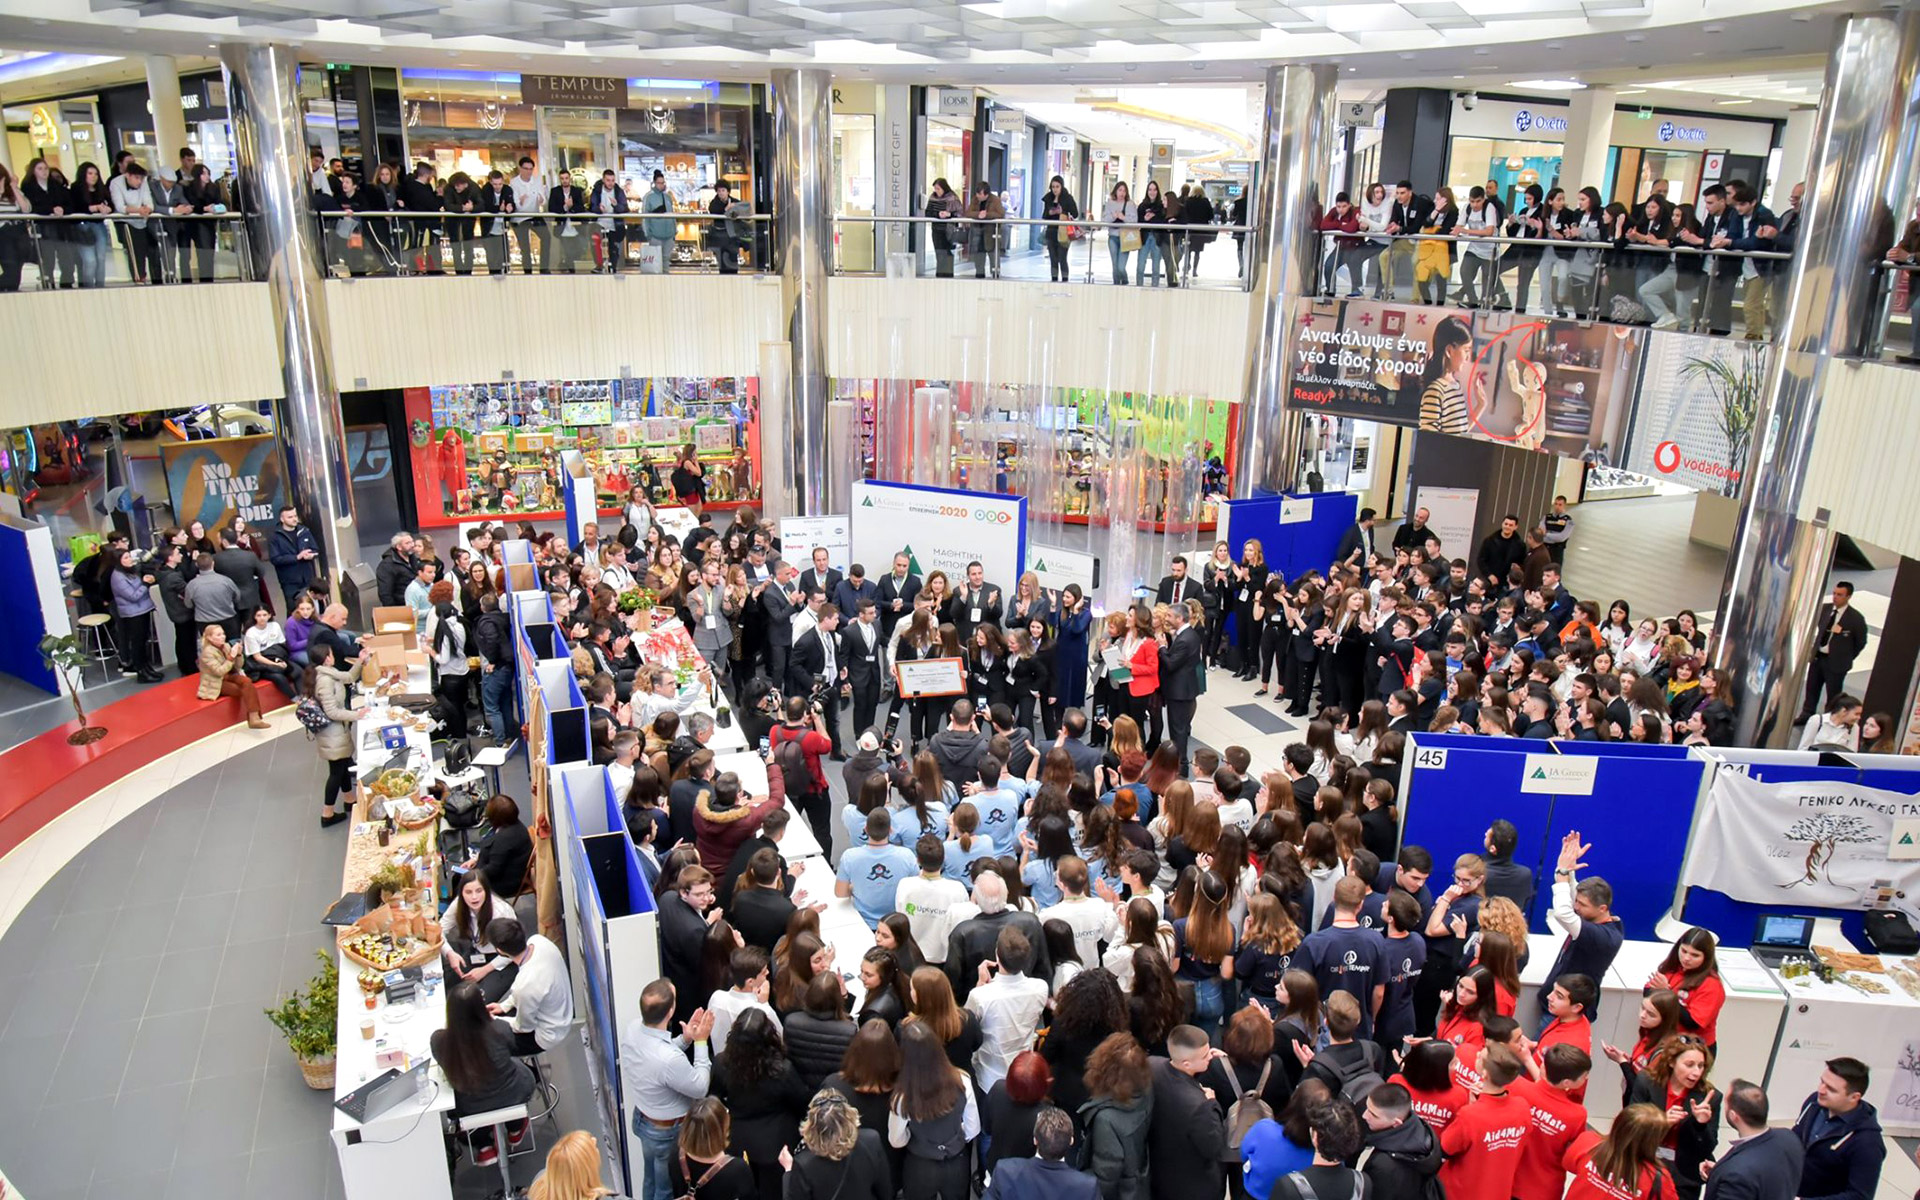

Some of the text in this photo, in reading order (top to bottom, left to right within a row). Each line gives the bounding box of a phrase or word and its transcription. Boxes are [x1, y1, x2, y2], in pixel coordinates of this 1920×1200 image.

[532, 76, 616, 92] TEMPUS
[943, 96, 969, 106] LOISIR
[892, 121, 900, 150] GIFT
[892, 152, 900, 208] PERFECT
[1299, 326, 1427, 353] Ανακάλυψε ένα
[1298, 346, 1425, 376] νέο είδος χορού
[1293, 387, 1335, 404] Ready?
[202, 462, 232, 480] NO
[1683, 459, 1741, 483] vodafone
[205, 475, 259, 496] TIME
[222, 492, 252, 509] TO
[239, 504, 274, 522] DIE
[939, 506, 968, 518] 2020
[933, 548, 983, 561] ΜΑΘΗΤΙΚΗ
[933, 559, 968, 569] ΕΜΠΟΡ
[1419, 750, 1443, 766] 45
[1548, 767, 1589, 778] JA Greece
[1799, 795, 1920, 815] ΓΕΝΙΚΟ ΛΥΚΕΙΟ ΓΑ
[1411, 1100, 1453, 1119] id4Mate
[1530, 1105, 1567, 1132] d4Mate
